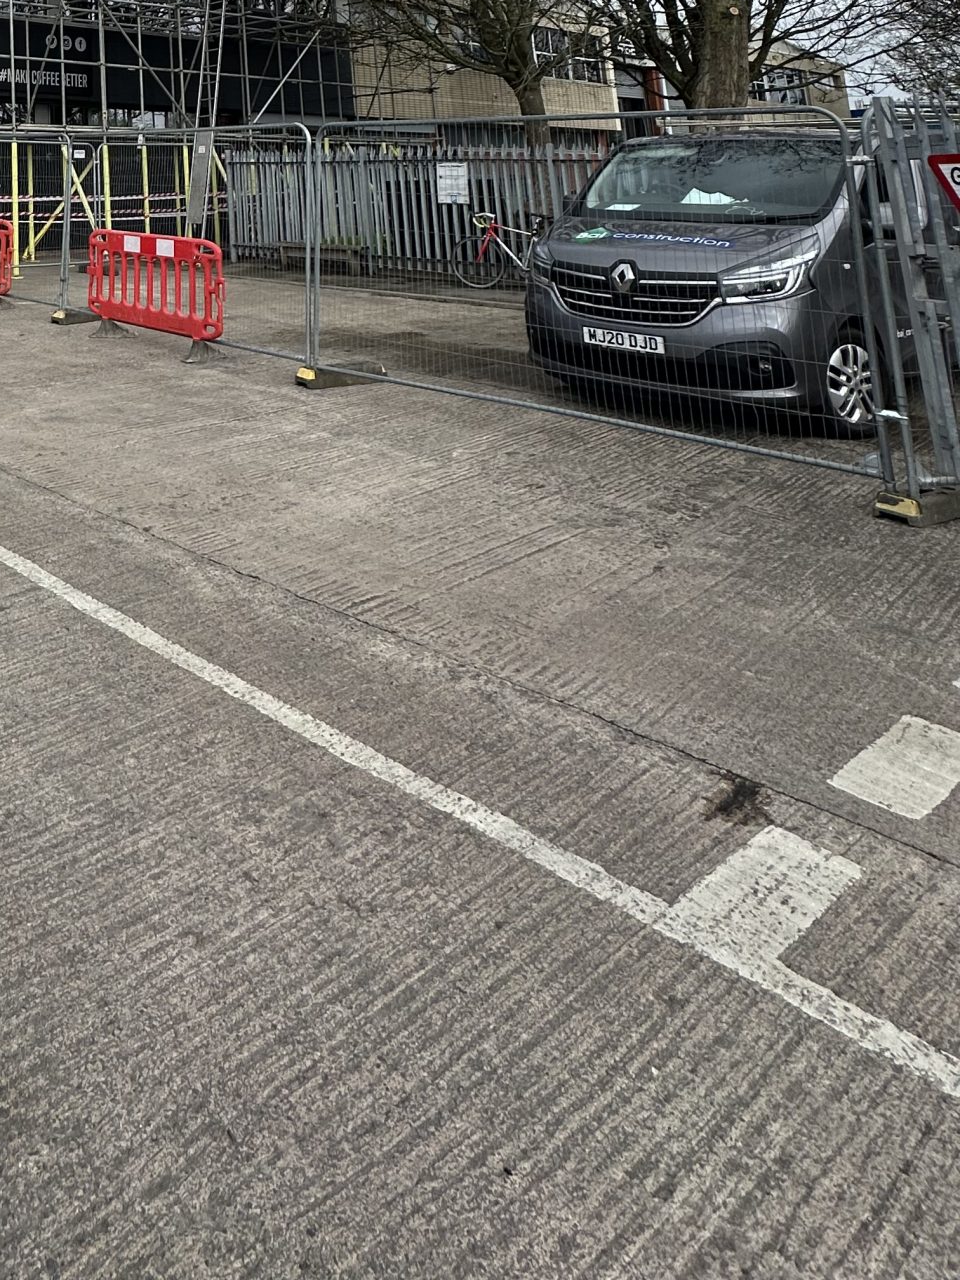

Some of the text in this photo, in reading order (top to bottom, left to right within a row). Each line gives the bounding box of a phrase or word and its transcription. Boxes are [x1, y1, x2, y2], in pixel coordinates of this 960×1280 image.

[613, 232, 730, 248] construction
[588, 328, 658, 351] MJ20 DJD
